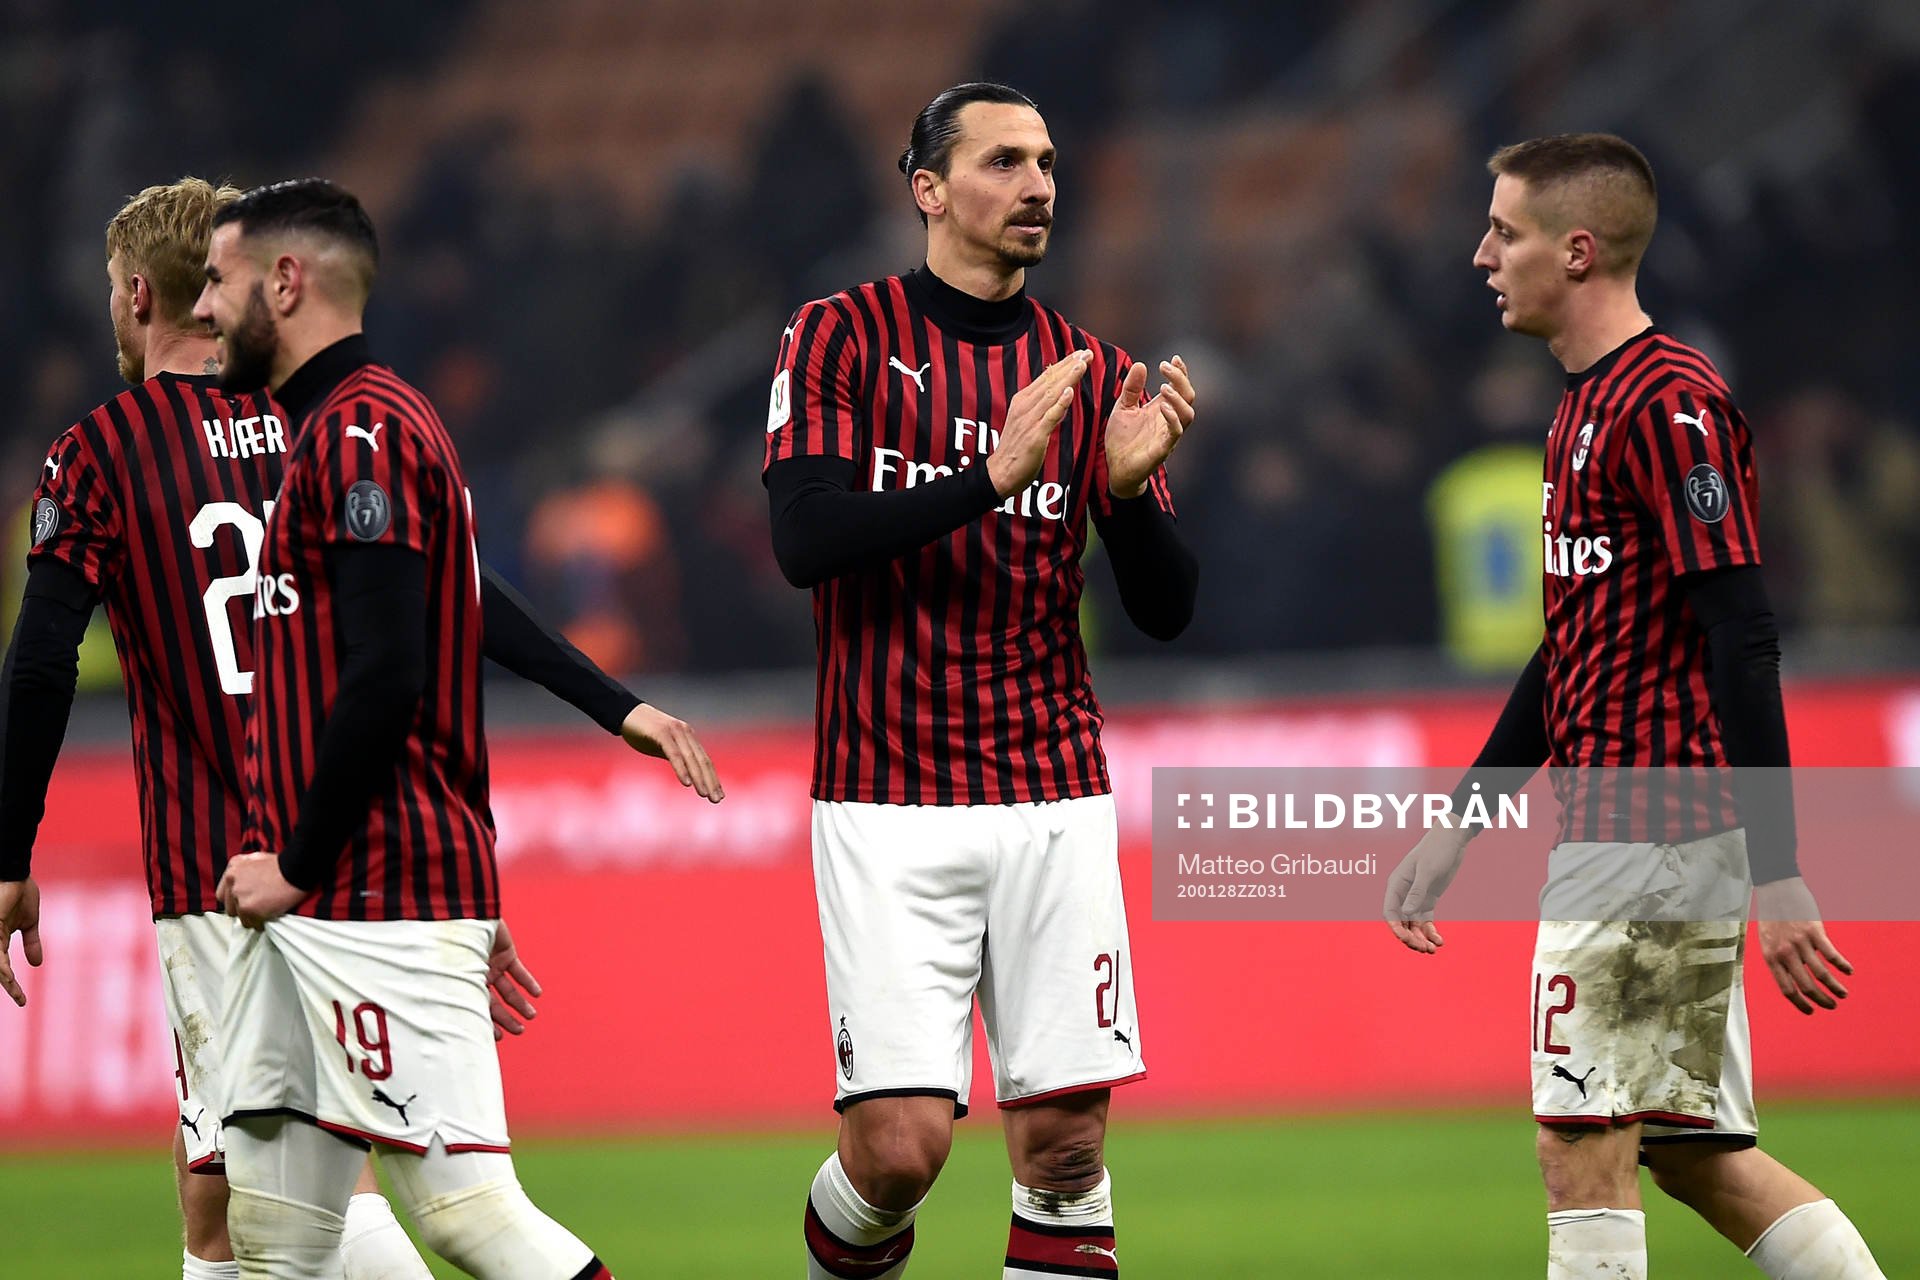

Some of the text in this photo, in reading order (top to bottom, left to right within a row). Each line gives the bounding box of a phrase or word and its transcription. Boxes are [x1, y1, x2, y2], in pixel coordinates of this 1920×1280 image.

[202, 414, 288, 460] KJÆR
[361, 509, 373, 526] 7
[1702, 491, 1713, 508] 7
[188, 499, 276, 695] 2
[1093, 948, 1120, 1029] 21
[1533, 972, 1577, 1056] 12
[332, 999, 393, 1082] 19
